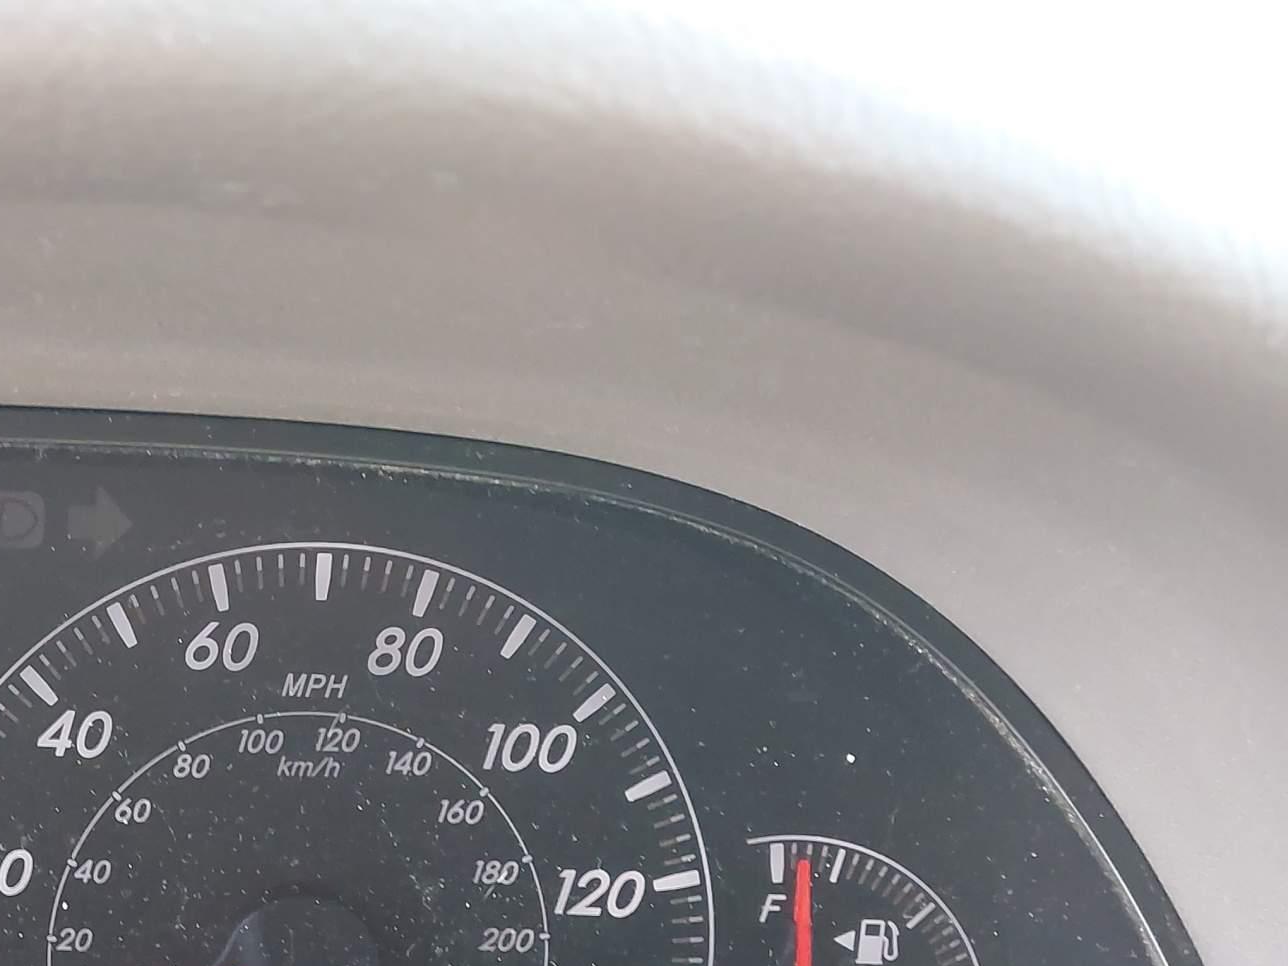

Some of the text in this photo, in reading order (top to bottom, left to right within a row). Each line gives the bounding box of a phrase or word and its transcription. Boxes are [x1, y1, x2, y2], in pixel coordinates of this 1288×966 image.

[185, 622, 259, 672] 60
[367, 626, 444, 676] 80
[281, 673, 348, 698] MPH
[37, 710, 112, 759] 40
[238, 729, 284, 755] 100
[315, 727, 360, 753] 120
[482, 723, 577, 774] 100
[173, 754, 210, 779] 80
[277, 755, 340, 778] km/h
[384, 750, 432, 776] 140
[114, 798, 151, 824] 60
[438, 799, 483, 824] 160
[74, 859, 110, 885] 40
[472, 860, 519, 885] 180
[554, 868, 645, 919] 120
[759, 894, 787, 923] F
[56, 927, 93, 952] 20
[478, 928, 534, 953] 200
